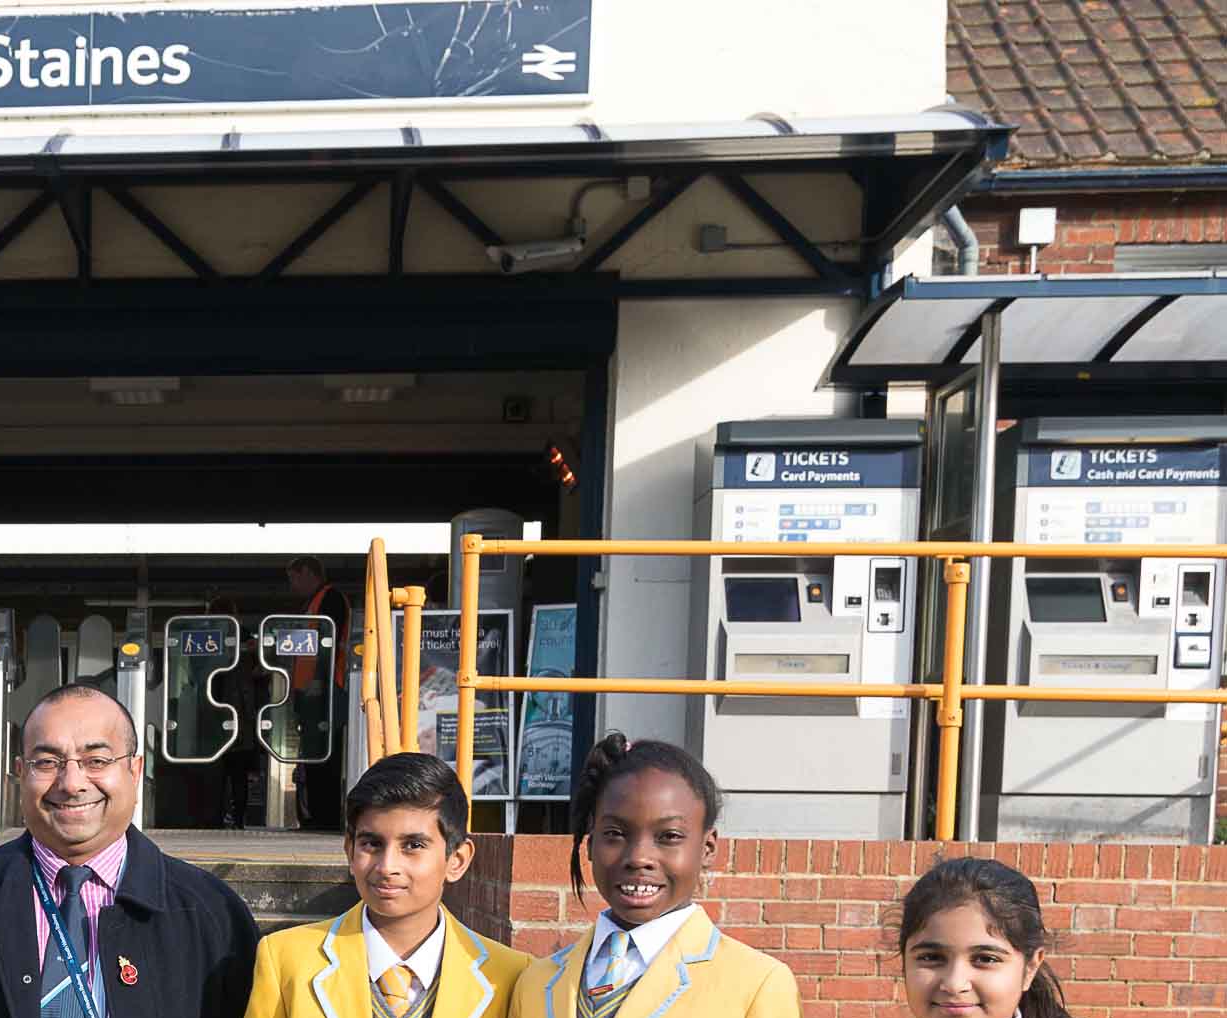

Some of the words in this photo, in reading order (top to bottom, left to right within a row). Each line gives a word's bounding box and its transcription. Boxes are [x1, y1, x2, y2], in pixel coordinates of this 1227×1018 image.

[782, 451, 849, 466] TICKETS
[1089, 449, 1157, 464] TICKETS
[781, 470, 806, 482] Card
[807, 470, 861, 483] Payments
[1087, 468, 1113, 481] Cash
[1115, 469, 1136, 480] and
[1138, 468, 1163, 480] Card
[1165, 468, 1220, 481] Payments
[422, 628, 449, 638] must
[427, 640, 456, 650] ticket
